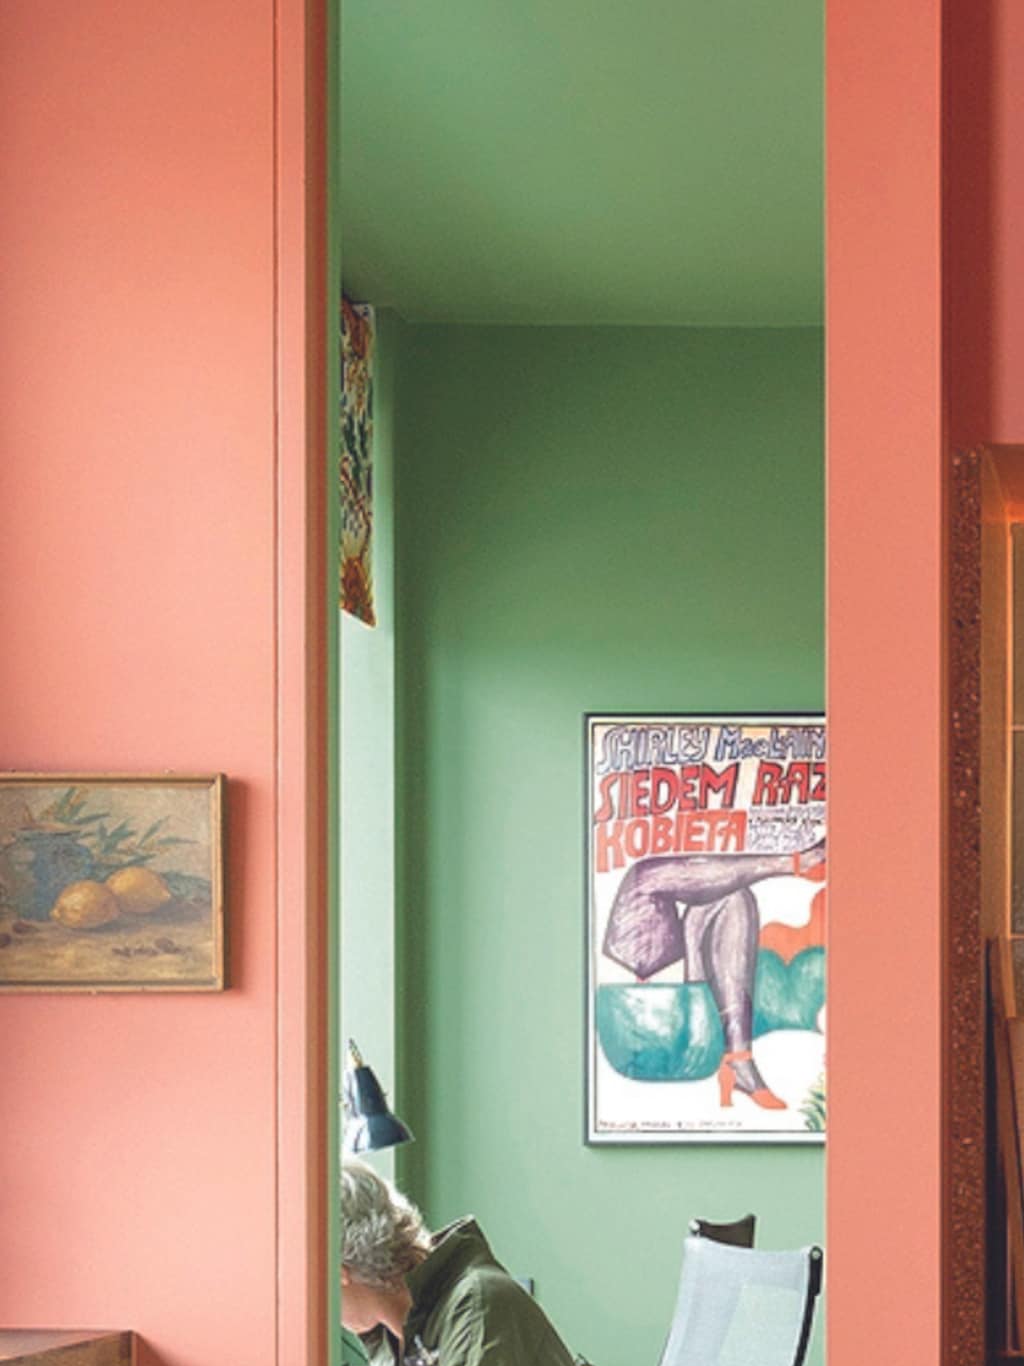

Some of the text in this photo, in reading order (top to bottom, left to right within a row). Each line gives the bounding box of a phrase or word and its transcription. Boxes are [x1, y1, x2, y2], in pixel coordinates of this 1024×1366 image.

[597, 724, 710, 774] SHIRLEY
[594, 762, 740, 822] SIEDEM
[596, 809, 747, 873] KOBIETA
